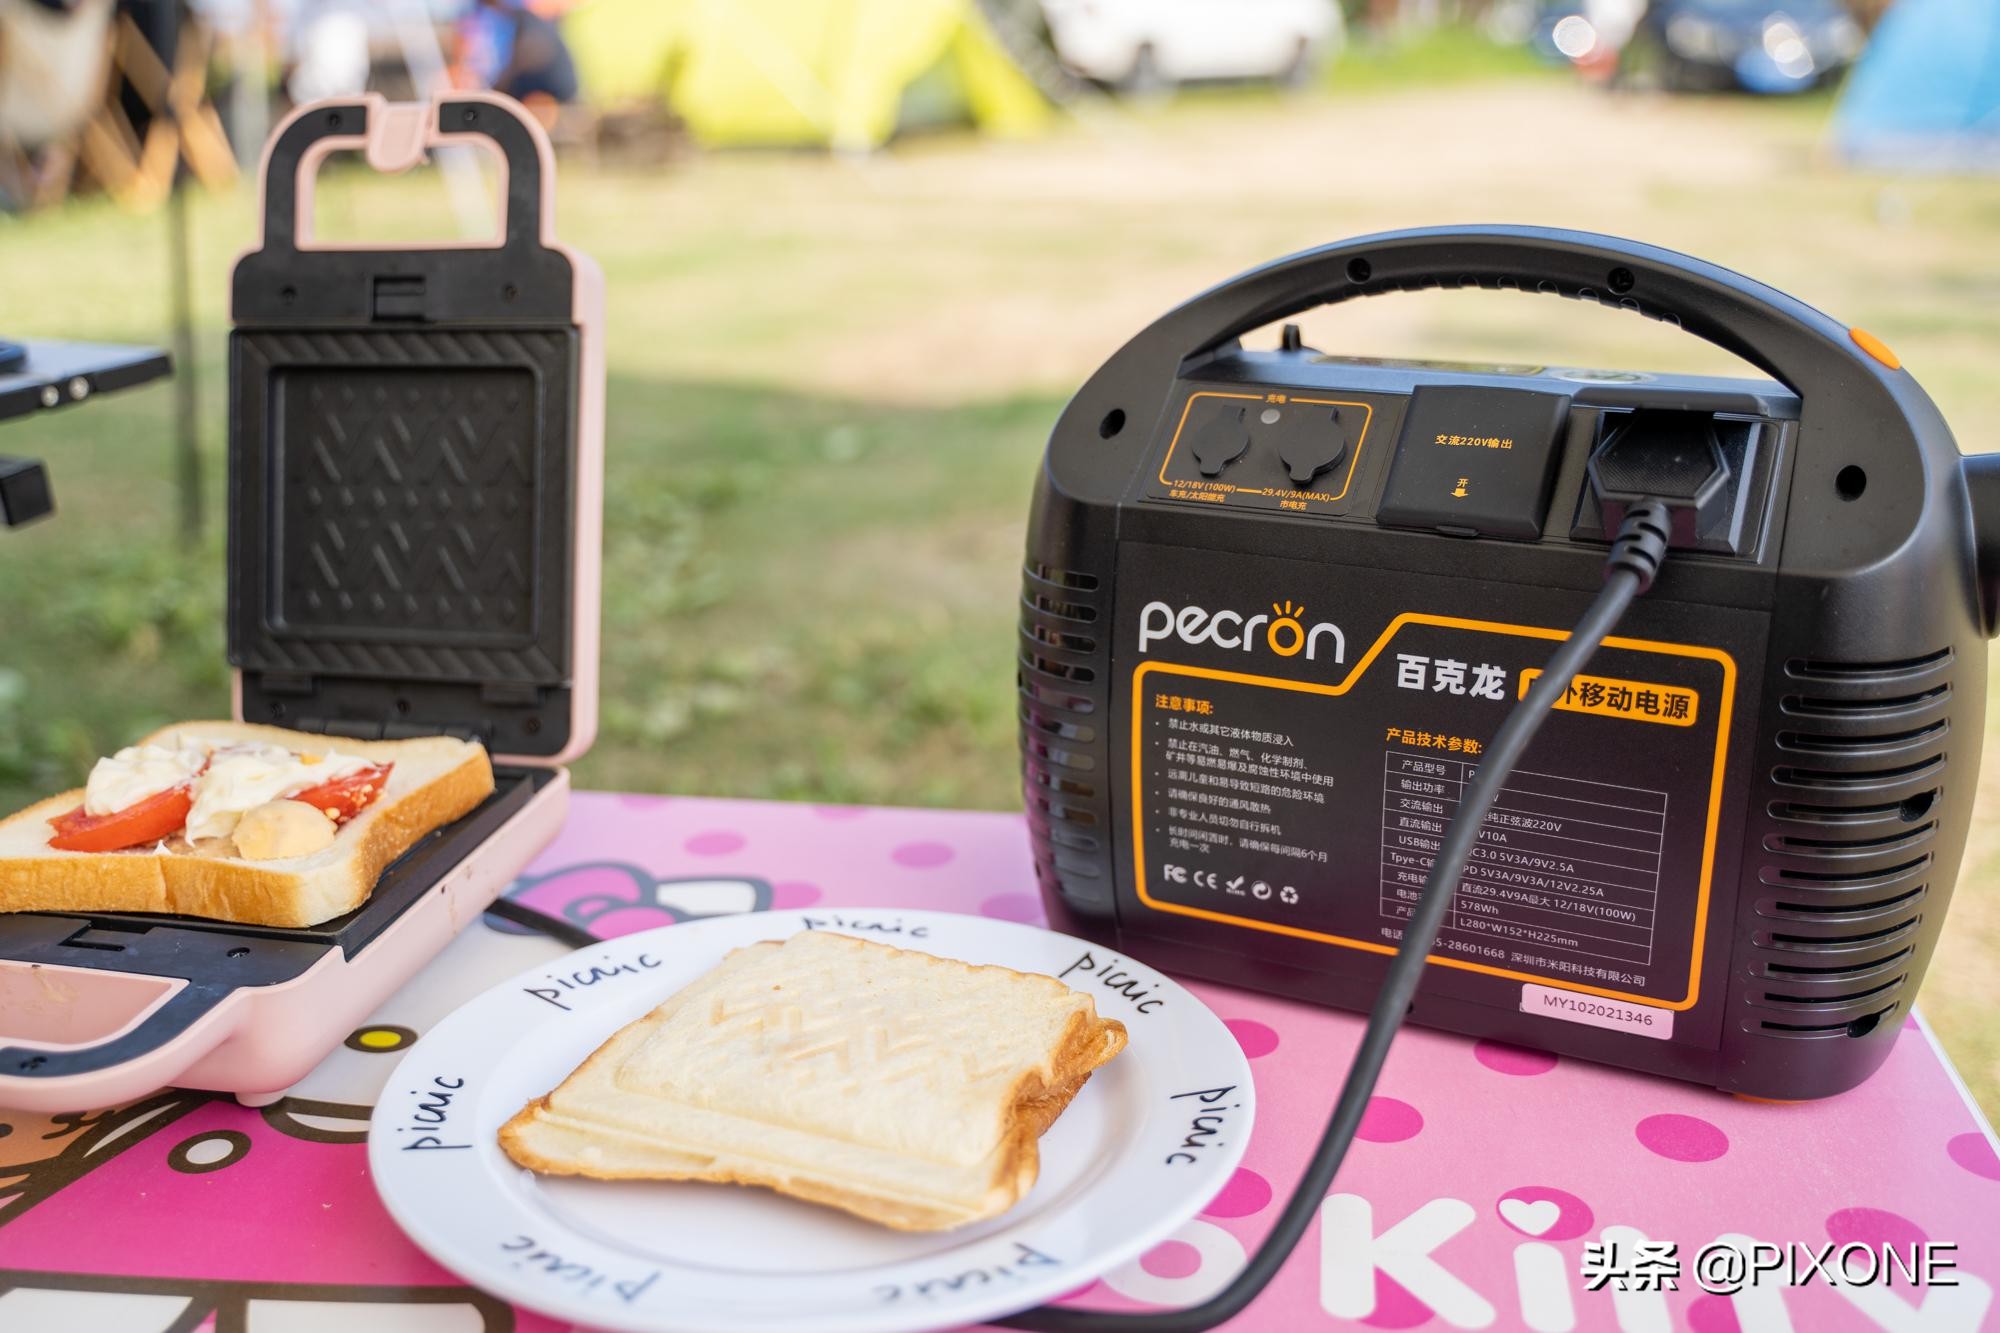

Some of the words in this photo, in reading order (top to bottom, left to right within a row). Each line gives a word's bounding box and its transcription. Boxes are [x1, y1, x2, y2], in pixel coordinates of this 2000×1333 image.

[1434, 434, 1513, 449] 交流220V输出
[1174, 479, 1203, 490] 12/18V
[1204, 482, 1237, 494] (100W)
[1456, 478, 1470, 488] 开
[1279, 500, 1308, 511] 市电充
[1138, 600, 1346, 665] pecron
[1396, 653, 1507, 701] 百克龙
[1529, 677, 1691, 720] 外移动电源
[1168, 717, 1295, 747] 禁止水或其它液体物质浸入
[1165, 750, 1334, 788] 矿井等易燃易爆及腐蚀性环境中使用
[1401, 760, 1447, 776] 产品型号
[1167, 768, 1326, 804] 远离儿童和易导致短路的危险环境
[1400, 778, 1446, 795] 输出功率
[1168, 787, 1272, 815] 请确保良好的通风散热
[1400, 798, 1444, 814] 交流输出
[1168, 806, 1282, 836] 非专业人员切勿自行拆机
[1399, 816, 1443, 833] 直流输出
[1482, 811, 1563, 833] 纯正弦波220V
[1169, 837, 1211, 854] 充电一次
[1398, 835, 1441, 851] USB输出
[1500, 852, 1575, 874] 5V3A/9V2.5A
[1396, 888, 1424, 901] 电池
[1463, 864, 1478, 875] PD
[1480, 867, 1605, 897] 5V3A/9V3A/12V2.25A
[1460, 900, 1500, 916] 578Wh
[1462, 882, 1550, 908] 直流29.4V9A最大
[1554, 899, 1637, 923] 12/18V(100W)
[1431, 937, 1505, 960] 5-28601668
[1511, 951, 1646, 988] 深圳市米阳科技有限公司
[522, 952, 662, 1011] picnic
[1058, 951, 1165, 1015] picnic
[1543, 993, 1653, 1027] MY102021346
[396, 1075, 474, 1151] picnic
[1164, 1084, 1241, 1167] picnic
